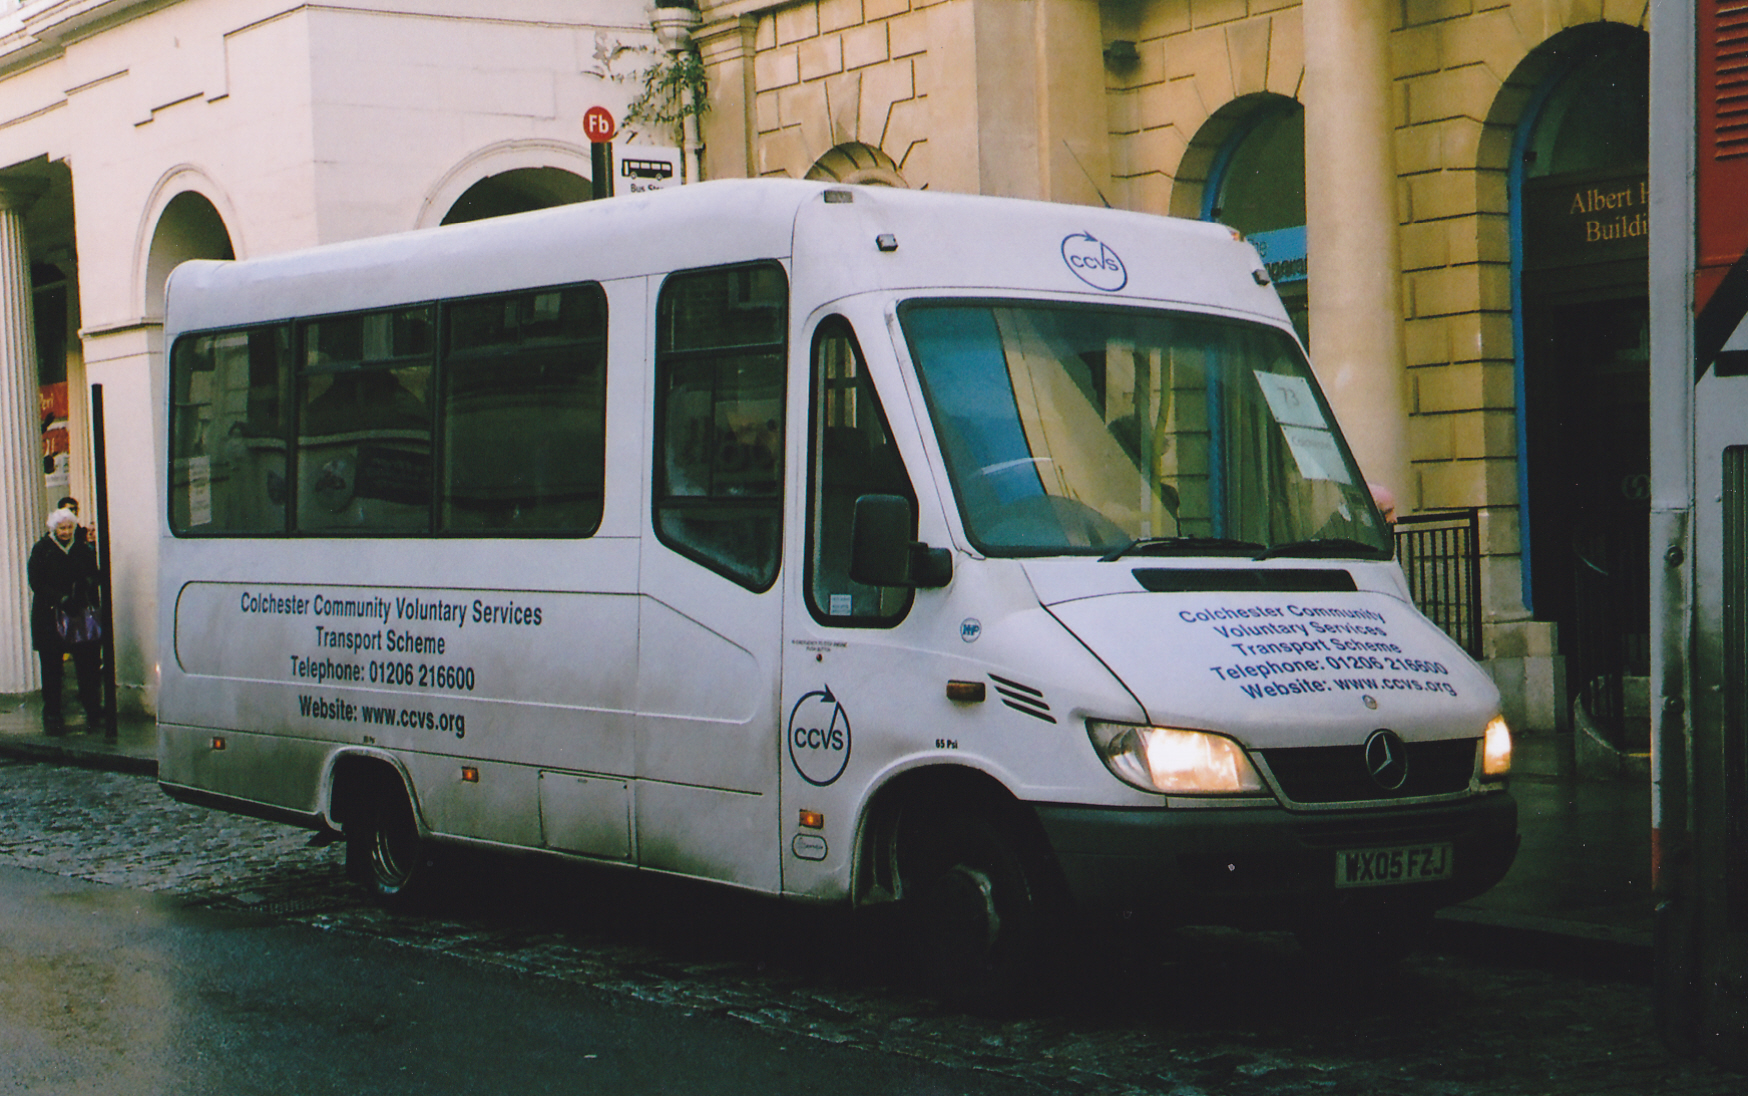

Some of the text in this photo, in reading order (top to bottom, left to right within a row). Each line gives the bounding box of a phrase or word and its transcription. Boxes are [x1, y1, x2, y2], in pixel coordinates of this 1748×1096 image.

[589, 114, 609, 133] Fb
[630, 183, 646, 193] Bus
[1570, 188, 1632, 214] Albert
[1586, 213, 1648, 242] Buildi
[1069, 248, 1119, 271] CCVS
[1278, 386, 1300, 407] 73
[241, 592, 543, 628] Colchester Community Voluntary Services
[1178, 604, 1386, 624] Colchester Community
[316, 626, 446, 655] Transport Scheme
[1213, 621, 1387, 639] Voluntary Services
[1231, 638, 1402, 656] Transport Scheme
[291, 655, 475, 691] Telephone: 01206 216600
[1209, 656, 1449, 681] Telephone: 01206 216600
[1240, 678, 1458, 699] Website: www.ccvs.org
[298, 695, 466, 739] Website: www.ccvs.org
[793, 715, 844, 751] CCVS
[1345, 846, 1447, 882] WX05 FZJ
